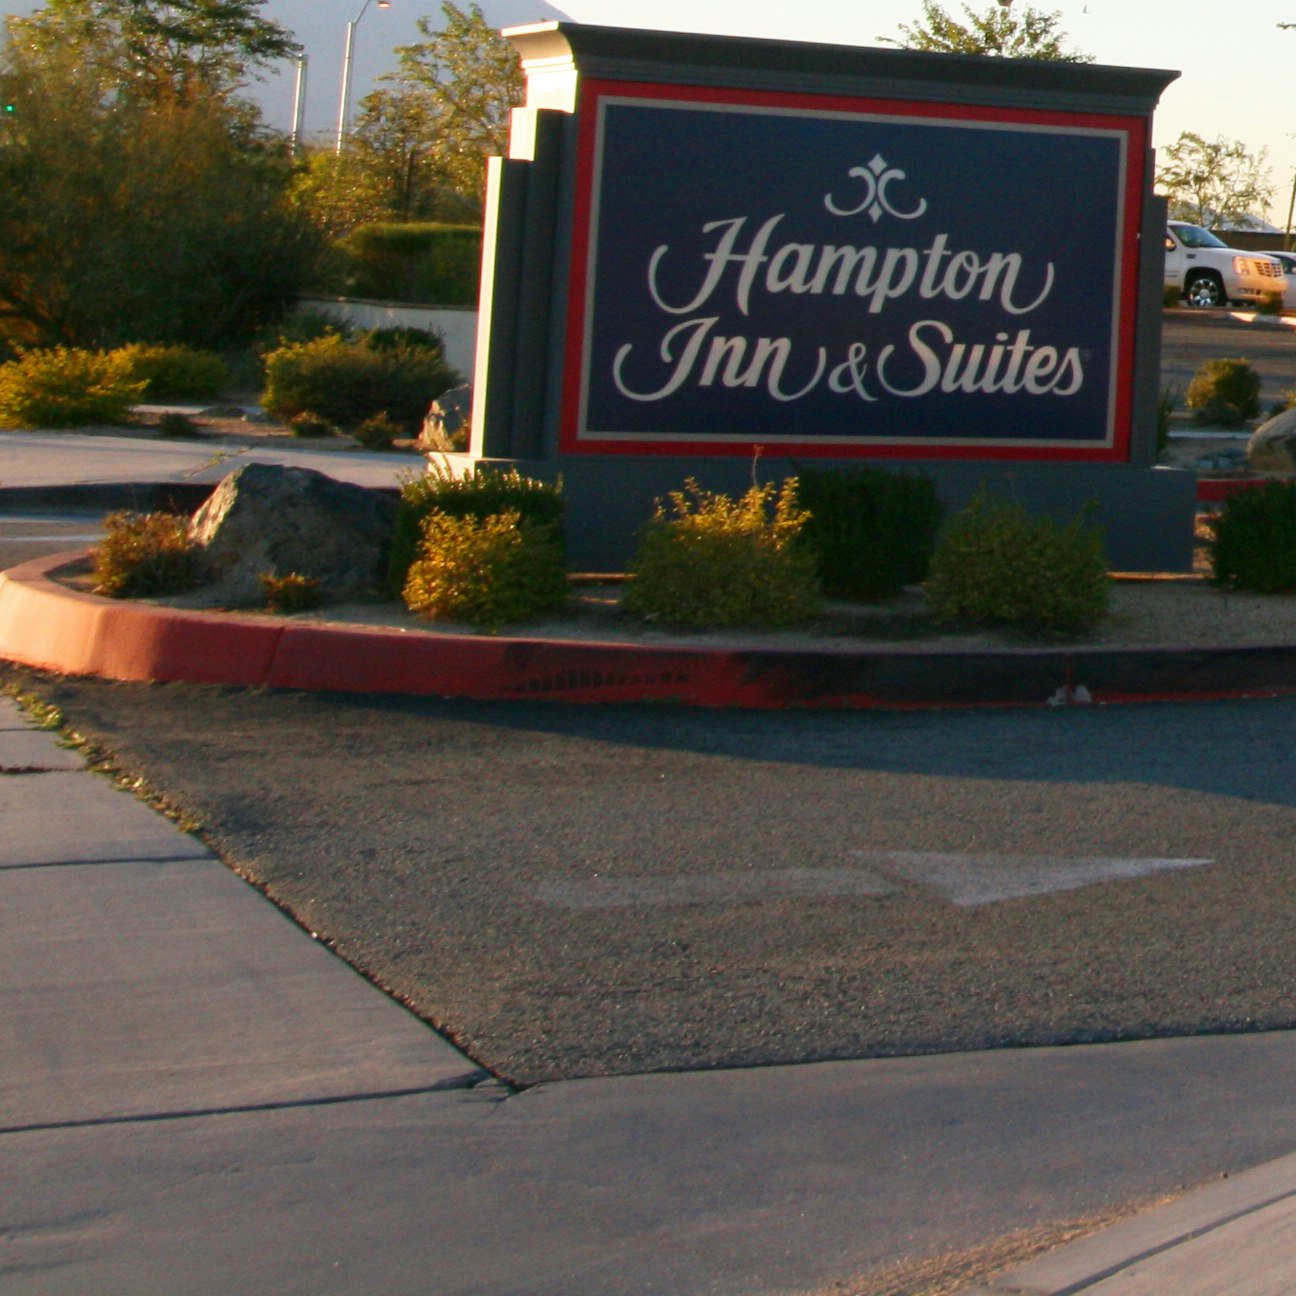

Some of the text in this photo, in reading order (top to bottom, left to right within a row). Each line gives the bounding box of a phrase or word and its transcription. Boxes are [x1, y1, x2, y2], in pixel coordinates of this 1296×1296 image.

[648, 213, 1055, 316] Hampton
[612, 315, 1084, 402] Inn & Suites
